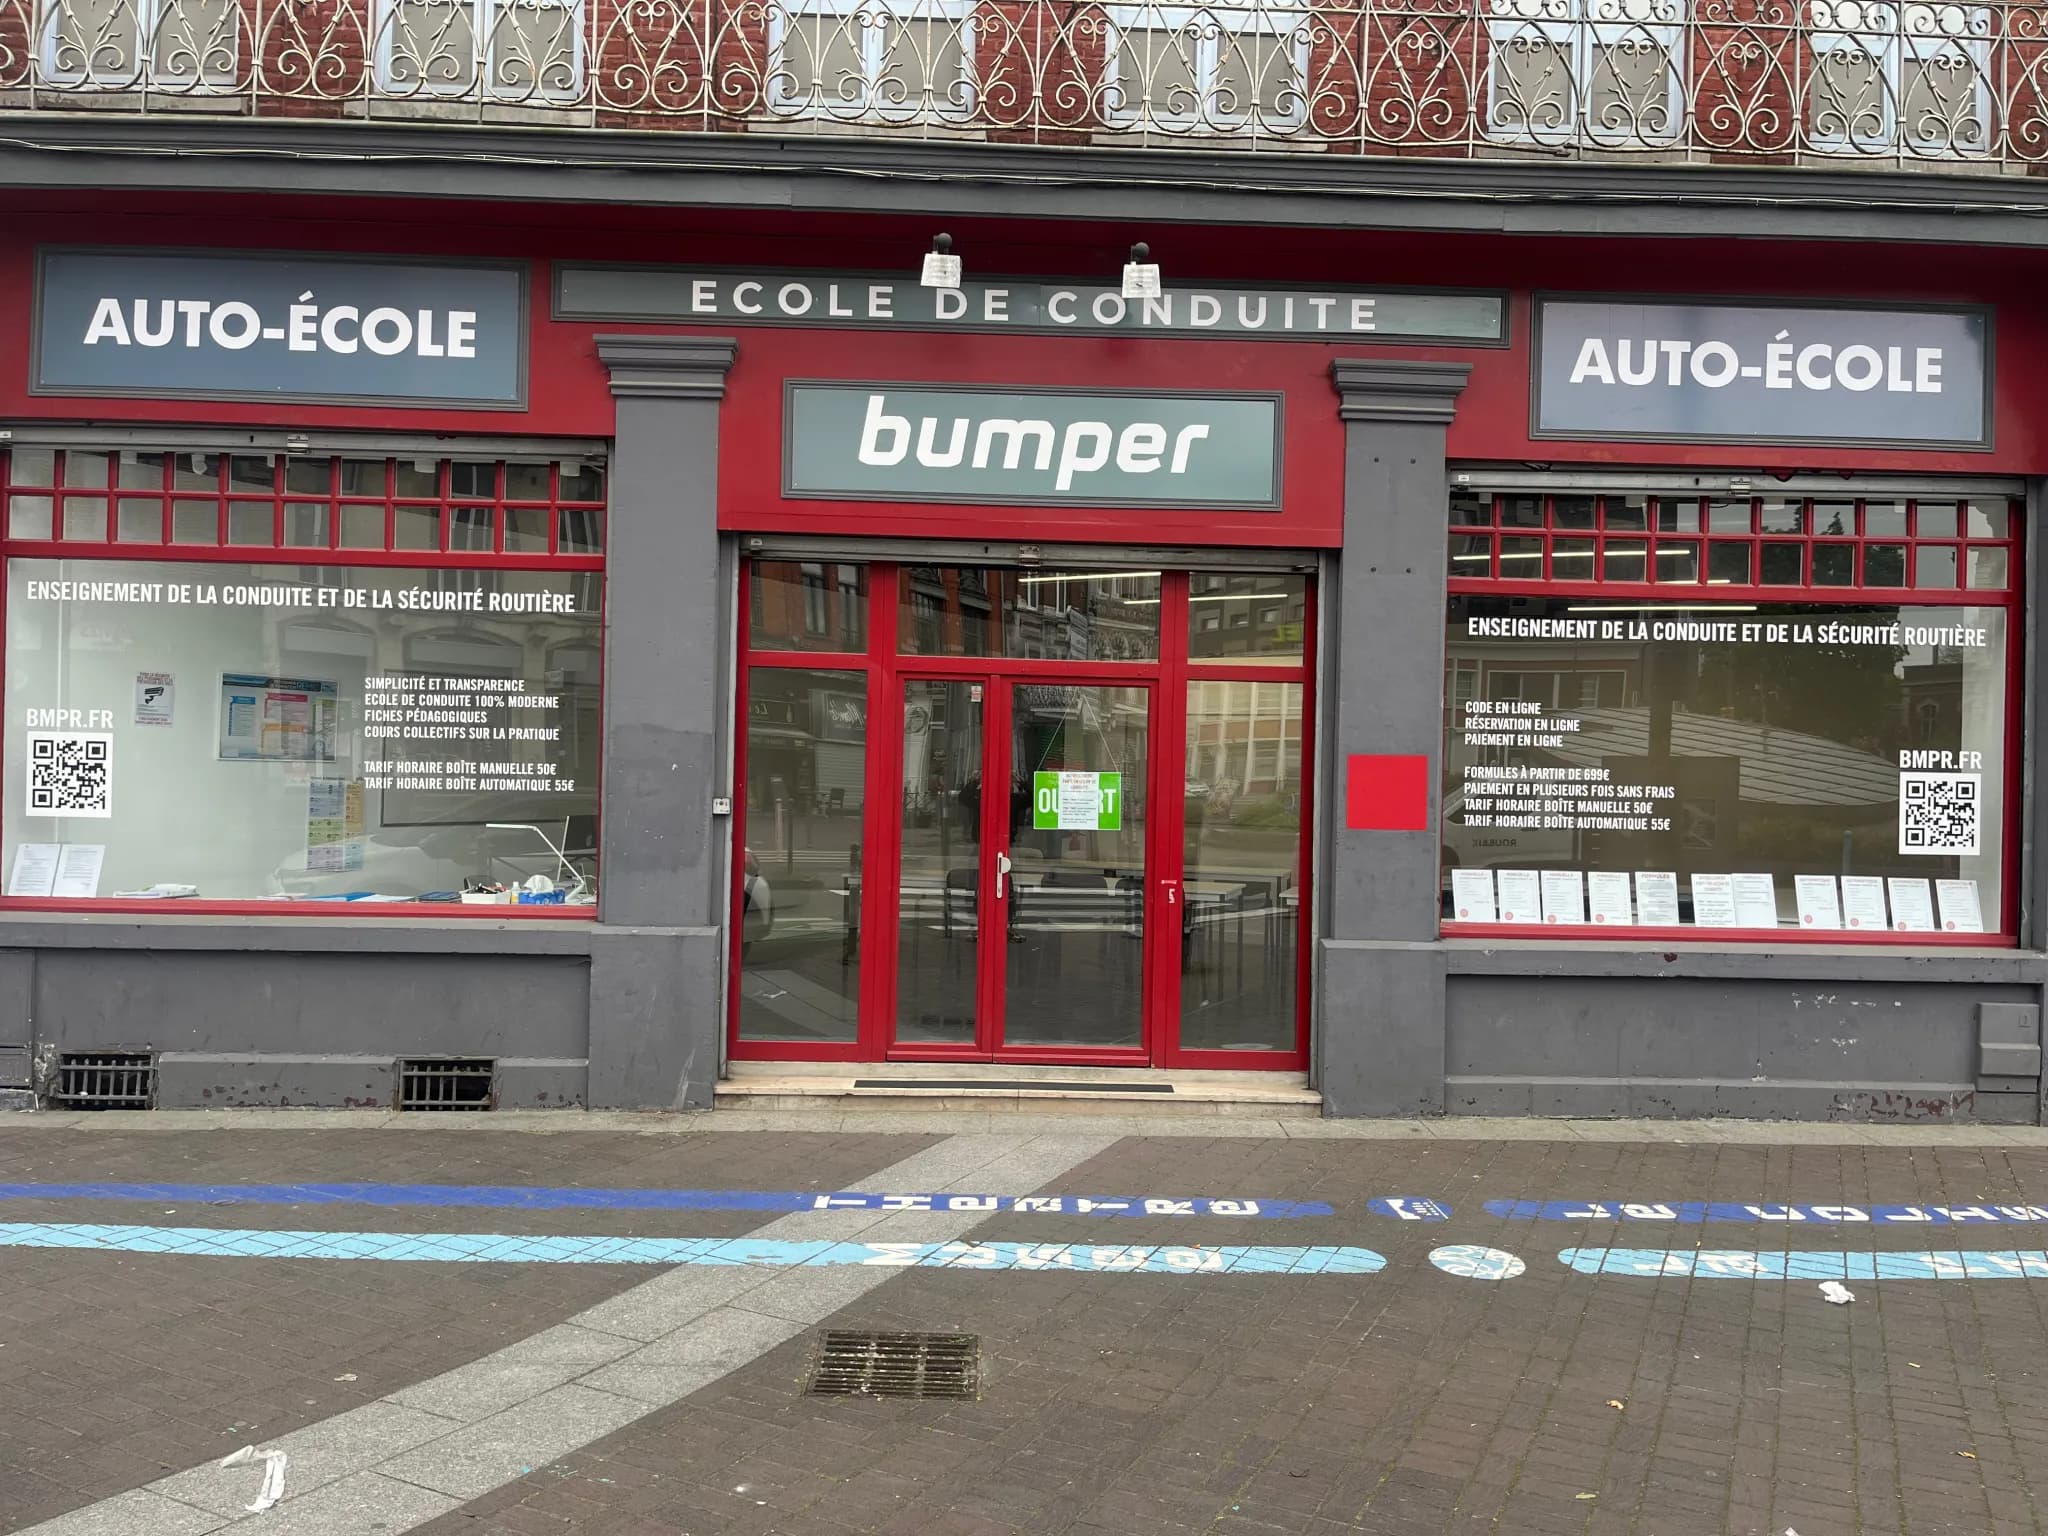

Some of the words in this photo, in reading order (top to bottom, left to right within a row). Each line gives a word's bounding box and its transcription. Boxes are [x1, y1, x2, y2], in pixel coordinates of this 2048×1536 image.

[692, 281, 895, 318] ECOLE
[936, 286, 1009, 322] DE
[1048, 291, 1376, 331] CONDUITE
[83, 290, 476, 358] AUTO-ÉCOLE
[1569, 329, 1942, 393] AUTO-ÉCOLE
[858, 395, 1210, 491] bumper
[27, 581, 162, 604] ENSEIGNEMENT
[168, 584, 191, 604] DE
[196, 585, 217, 605] LA
[223, 585, 312, 607] CONDUITE
[318, 588, 338, 607] ET
[344, 589, 367, 608] DE
[372, 590, 393, 609] LA
[398, 586, 483, 612] SÉCURITÉ
[489, 587, 575, 614] ROUTIÈRE
[1468, 617, 1597, 640] ENSEIGNEMENT
[1602, 620, 1624, 640] DE
[1630, 621, 1648, 641] LA
[1653, 621, 1736, 642] CONDUITE
[1741, 623, 1762, 643] ET
[1767, 624, 1789, 643] DE
[1795, 625, 1813, 644] LA
[1818, 620, 1899, 646] SÉCURITÉ
[1904, 622, 1986, 648] ROUTIÈRE
[365, 676, 425, 690] SIMPLICITÉ
[429, 679, 441, 690] ET
[444, 679, 524, 692] TRANSPARENCE
[365, 694, 399, 705] ECOLE
[402, 695, 415, 706] DE
[419, 695, 471, 706] CONDUITE
[475, 696, 504, 707] 100%
[508, 697, 559, 708] MODERNE
[1465, 702, 1492, 713] CODE
[1496, 702, 1508, 713] EN
[1512, 702, 1541, 714] LIGNE
[26, 709, 113, 729] BMPR.FR
[365, 710, 402, 722] FICHES
[407, 709, 487, 723] PÉDAGOGIQUES
[1465, 716, 1531, 730] RÉSERVATION
[1535, 719, 1547, 730] EN
[1551, 720, 1580, 731] LIGNE
[365, 726, 400, 738] COURS
[404, 727, 465, 739] COLLECTIFS
[469, 728, 489, 739] SUR
[493, 728, 505, 739] LA
[509, 729, 559, 741] PRATIQUE
[1465, 734, 1515, 746] PAIEMENT
[1518, 734, 1530, 746] EN
[1534, 735, 1563, 747] LIGNE
[364, 761, 393, 772] TARIF
[397, 762, 442, 773] HORAIRE
[447, 760, 477, 774] BOÎTE
[480, 763, 533, 775] MANUELLE
[537, 764, 556, 775] 50€
[1899, 750, 1981, 770] BMPR.FR
[1465, 766, 1518, 779] FORMULES
[1521, 765, 1527, 779] À
[1530, 768, 1565, 780] PARTIR
[1568, 769, 1581, 780] DE
[1584, 769, 1609, 780] 699€
[364, 778, 393, 789] TARIF
[397, 778, 442, 790] HORAIRE
[446, 777, 476, 790] BOÎTE
[480, 779, 551, 792] AUTOMATIQUE
[555, 780, 575, 792] 55€
[1464, 783, 1514, 795] PAIEMENT
[1517, 784, 1529, 795] EN
[1533, 784, 1588, 796] PLUSIEURS
[1592, 785, 1614, 797] FOIS
[1617, 786, 1642, 798] SANS
[1645, 787, 1674, 798] FRAIS
[1464, 799, 1493, 810] TARIF
[1496, 800, 1541, 811] HORAIRE
[1545, 799, 1574, 812] BOÎTE
[1577, 801, 1630, 813] MANUELLE
[1634, 802, 1653, 814] 50€
[1464, 815, 1492, 826] TARIF
[1496, 816, 1540, 827] HORAIRE
[1544, 815, 1574, 828] BOÎTE
[1577, 818, 1647, 830] AUTOMATIQUE
[1651, 819, 1670, 830] 55€
